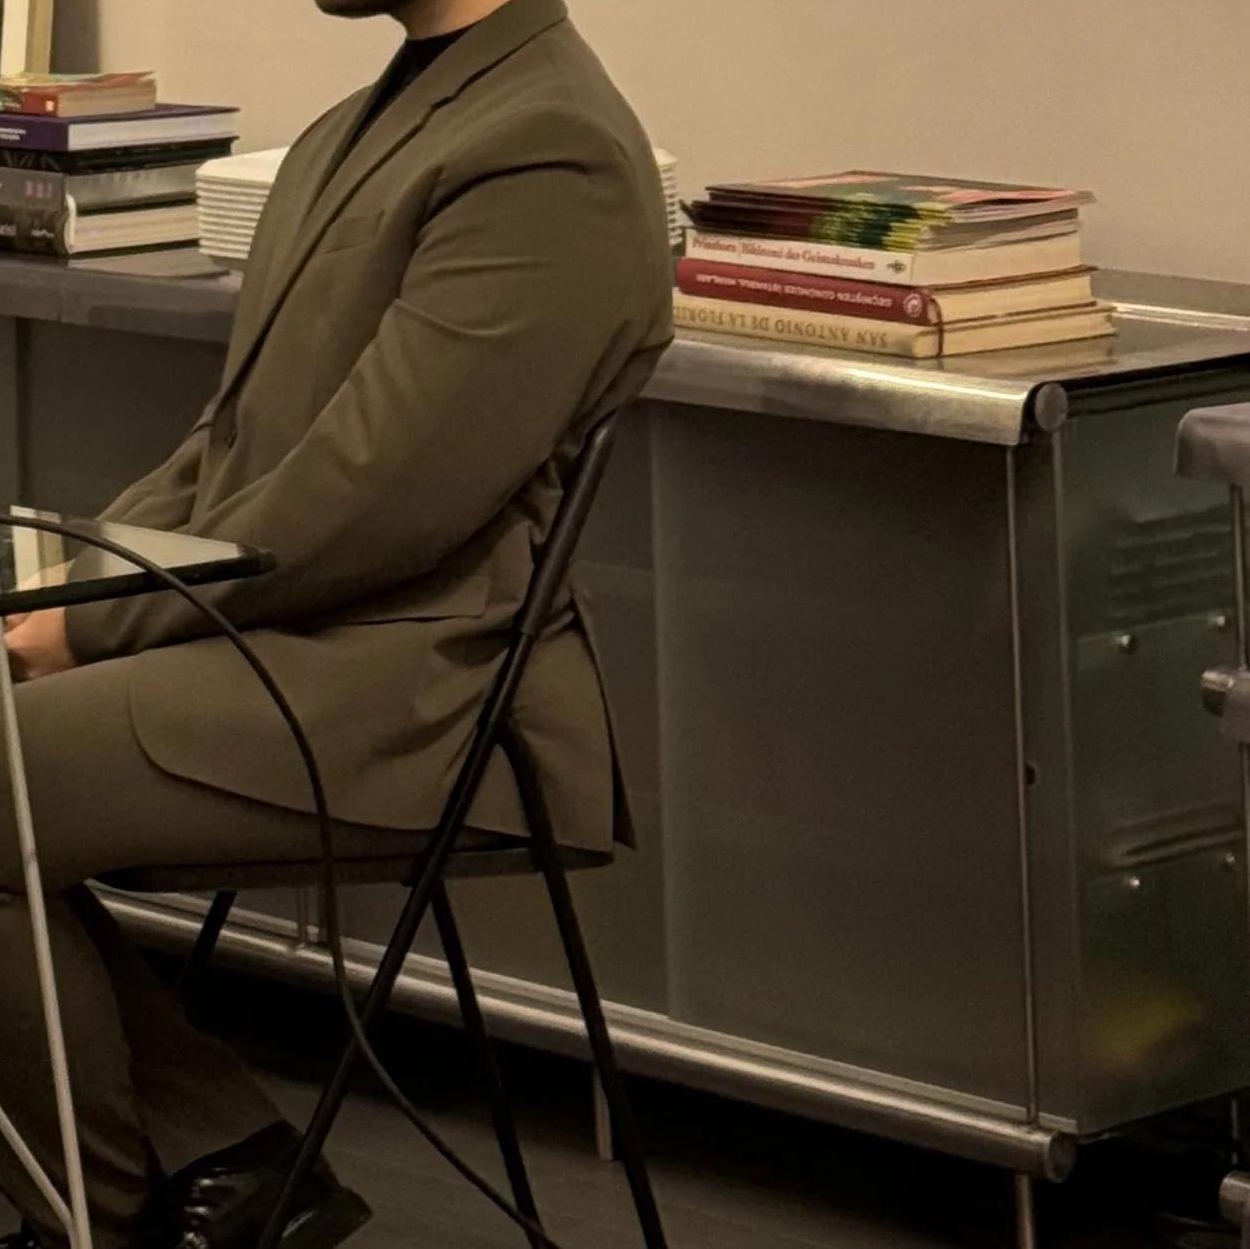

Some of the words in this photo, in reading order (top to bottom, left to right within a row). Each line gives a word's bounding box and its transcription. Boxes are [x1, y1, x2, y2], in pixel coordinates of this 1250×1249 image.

[728, 312, 746, 327] LA
[751, 316, 770, 331] DE
[774, 319, 849, 342] ANTONIO
[856, 330, 888, 348] SAN
